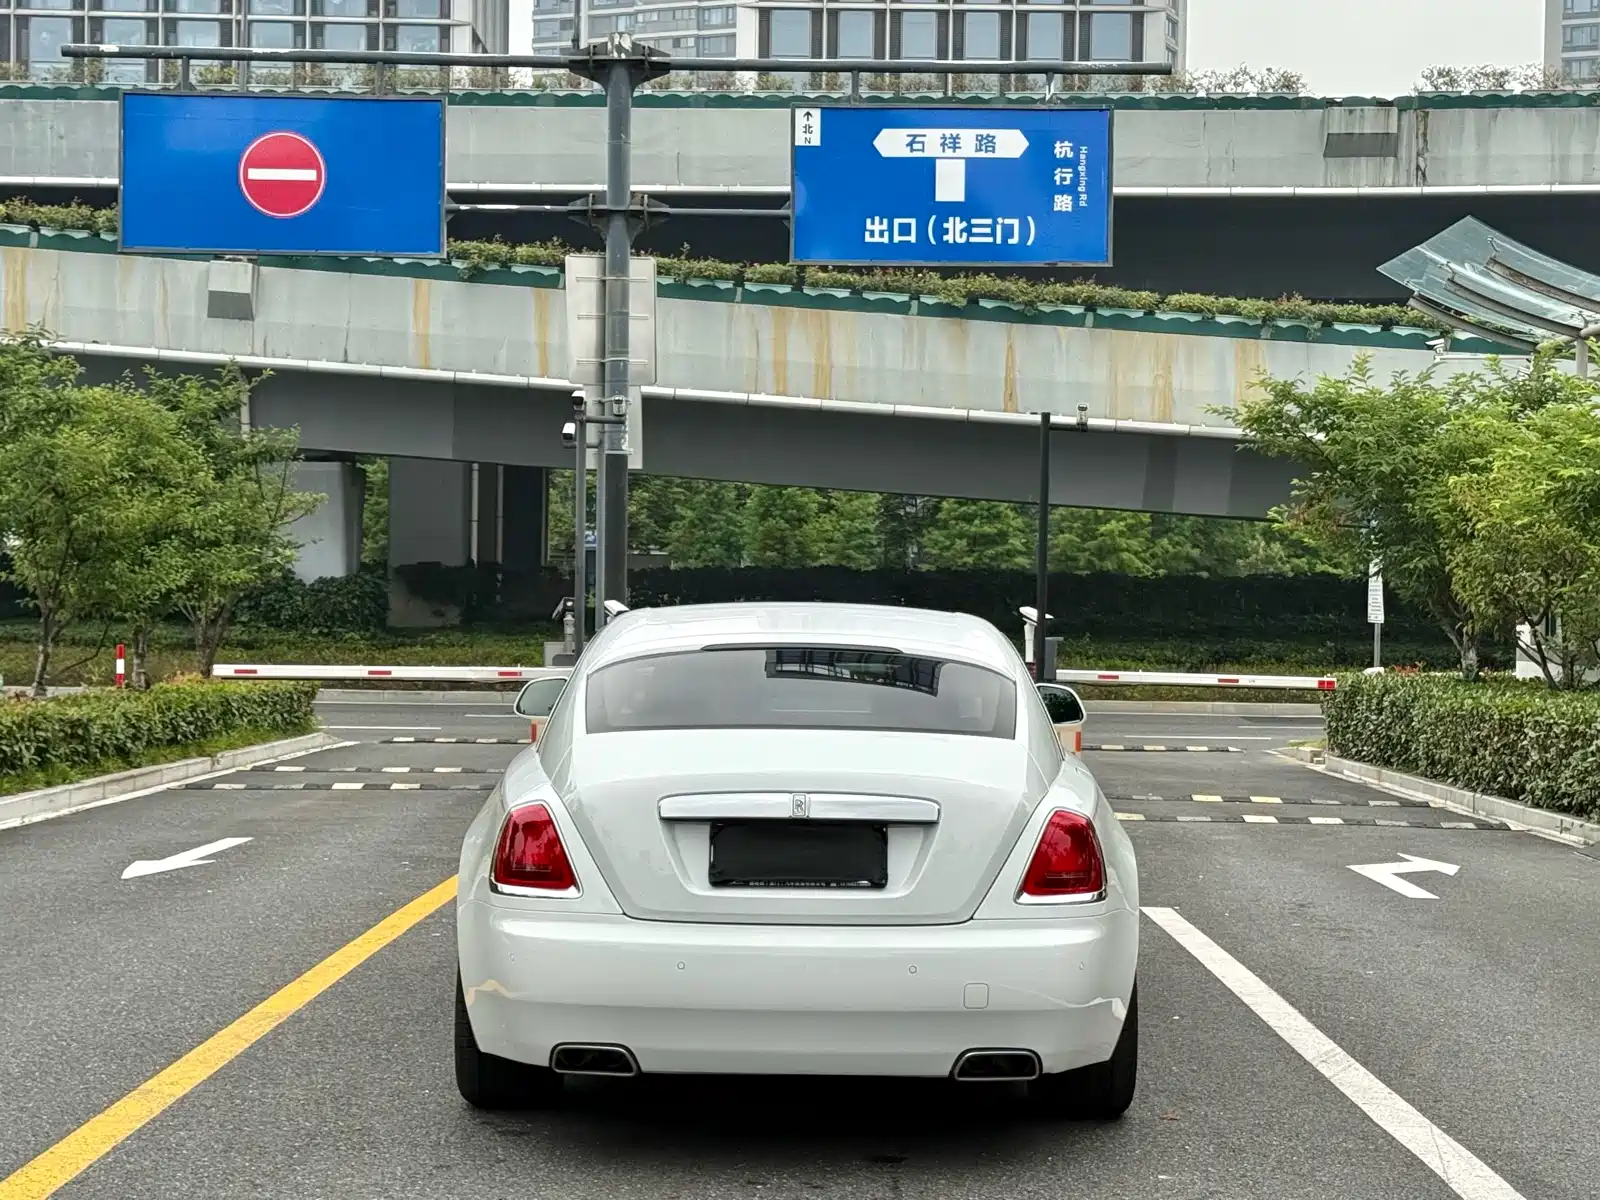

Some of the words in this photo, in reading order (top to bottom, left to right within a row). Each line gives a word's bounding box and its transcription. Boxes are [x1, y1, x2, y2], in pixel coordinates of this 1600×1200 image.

[802, 123, 814, 135] 北
[804, 136, 812, 145] N
[905, 133, 997, 154] 石祥路
[1053, 140, 1073, 212] 杭行路
[1077, 145, 1088, 193] Hangxing
[1079, 194, 1088, 207] Rd
